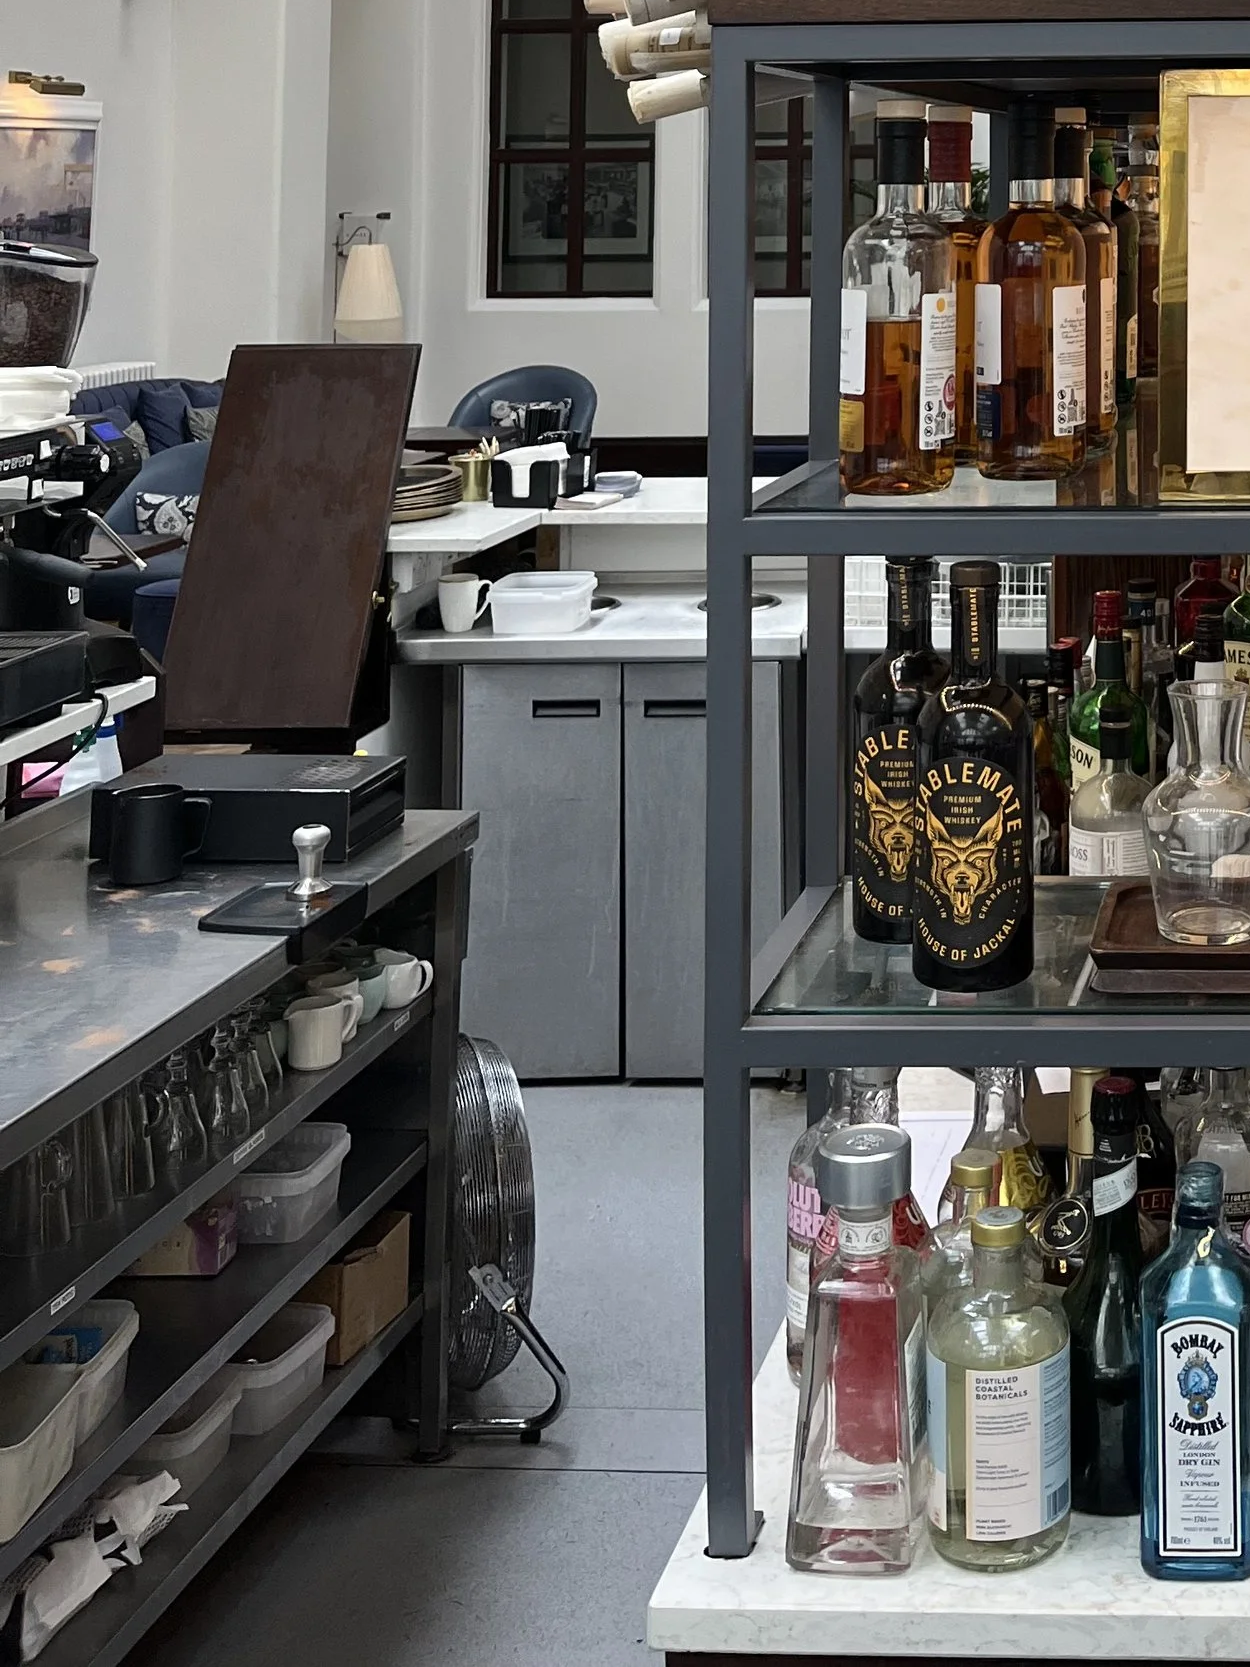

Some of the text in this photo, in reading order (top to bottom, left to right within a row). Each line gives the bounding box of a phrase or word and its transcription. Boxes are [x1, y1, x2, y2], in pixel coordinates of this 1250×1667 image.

[854, 729, 916, 797] STABLE
[887, 770, 909, 778] IRISH
[915, 762, 1022, 834] STABLEMATE
[944, 796, 982, 804] PREMIUM
[950, 806, 974, 814] IRISH
[944, 816, 982, 824] WHISKEY
[858, 876, 904, 916] HOUSE OF
[940, 906, 948, 920] IN
[918, 917, 1016, 962] HOUSE OF JACKAL
[1171, 1334, 1224, 1359] BOMBAY
[976, 1376, 1018, 1385] DISTILLED
[976, 1385, 1014, 1393] COASTAL
[976, 1390, 1028, 1400] BOTANICALS
[1168, 1411, 1227, 1437] SAPPHIRE
[1179, 1438, 1220, 1451] Distilled
